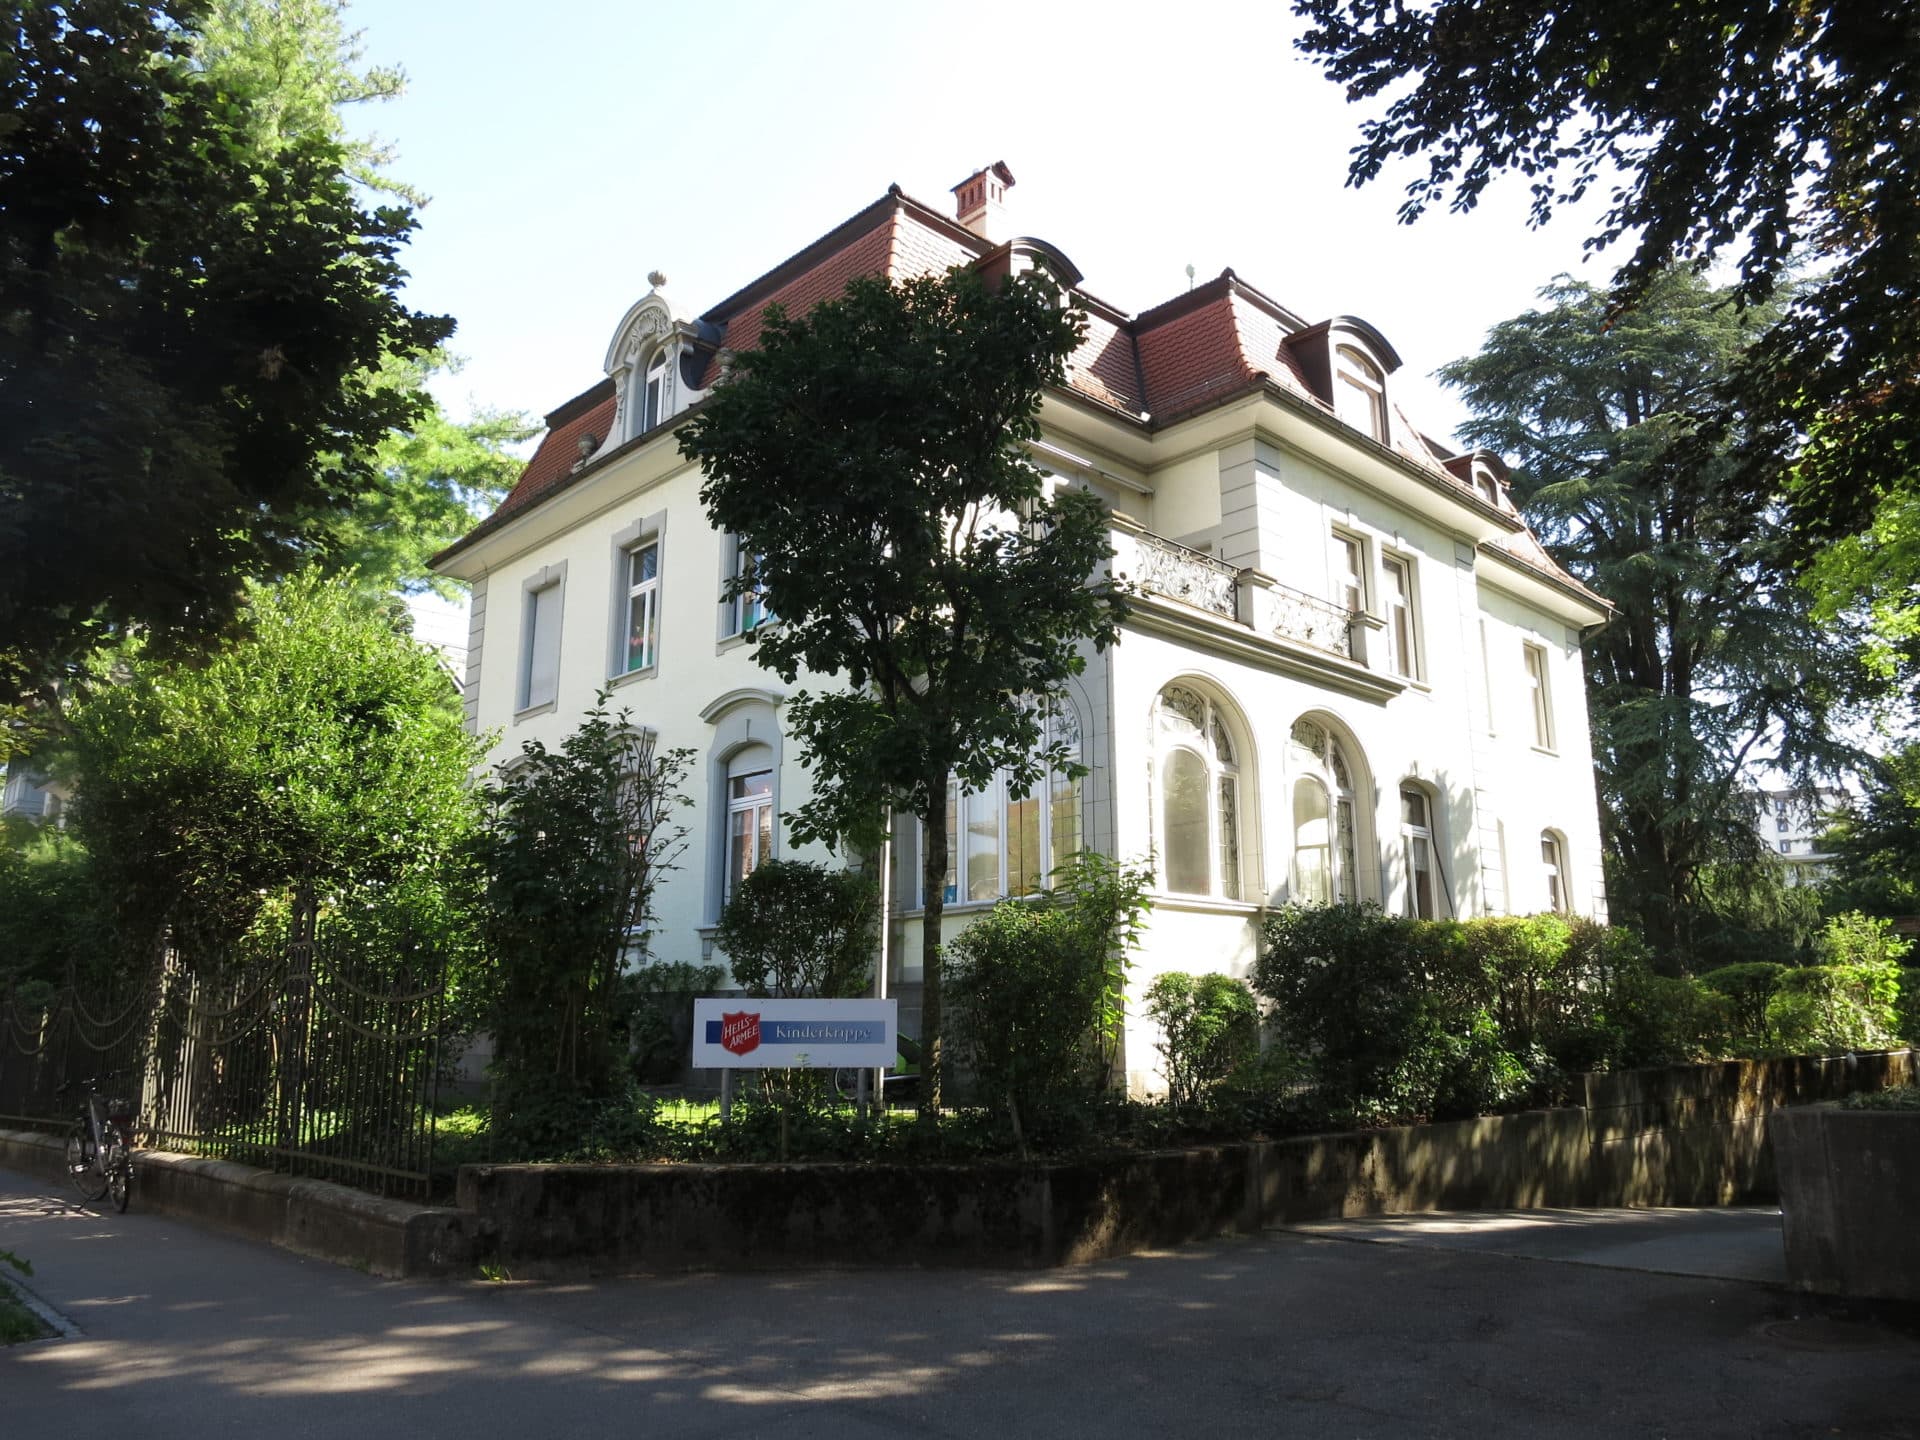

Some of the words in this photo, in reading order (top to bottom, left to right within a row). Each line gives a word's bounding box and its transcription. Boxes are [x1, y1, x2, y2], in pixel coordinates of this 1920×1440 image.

[724, 1016, 753, 1039] HEILS-
[729, 1024, 759, 1049] ARMEE
[776, 1024, 871, 1042] Kinderkrippe
